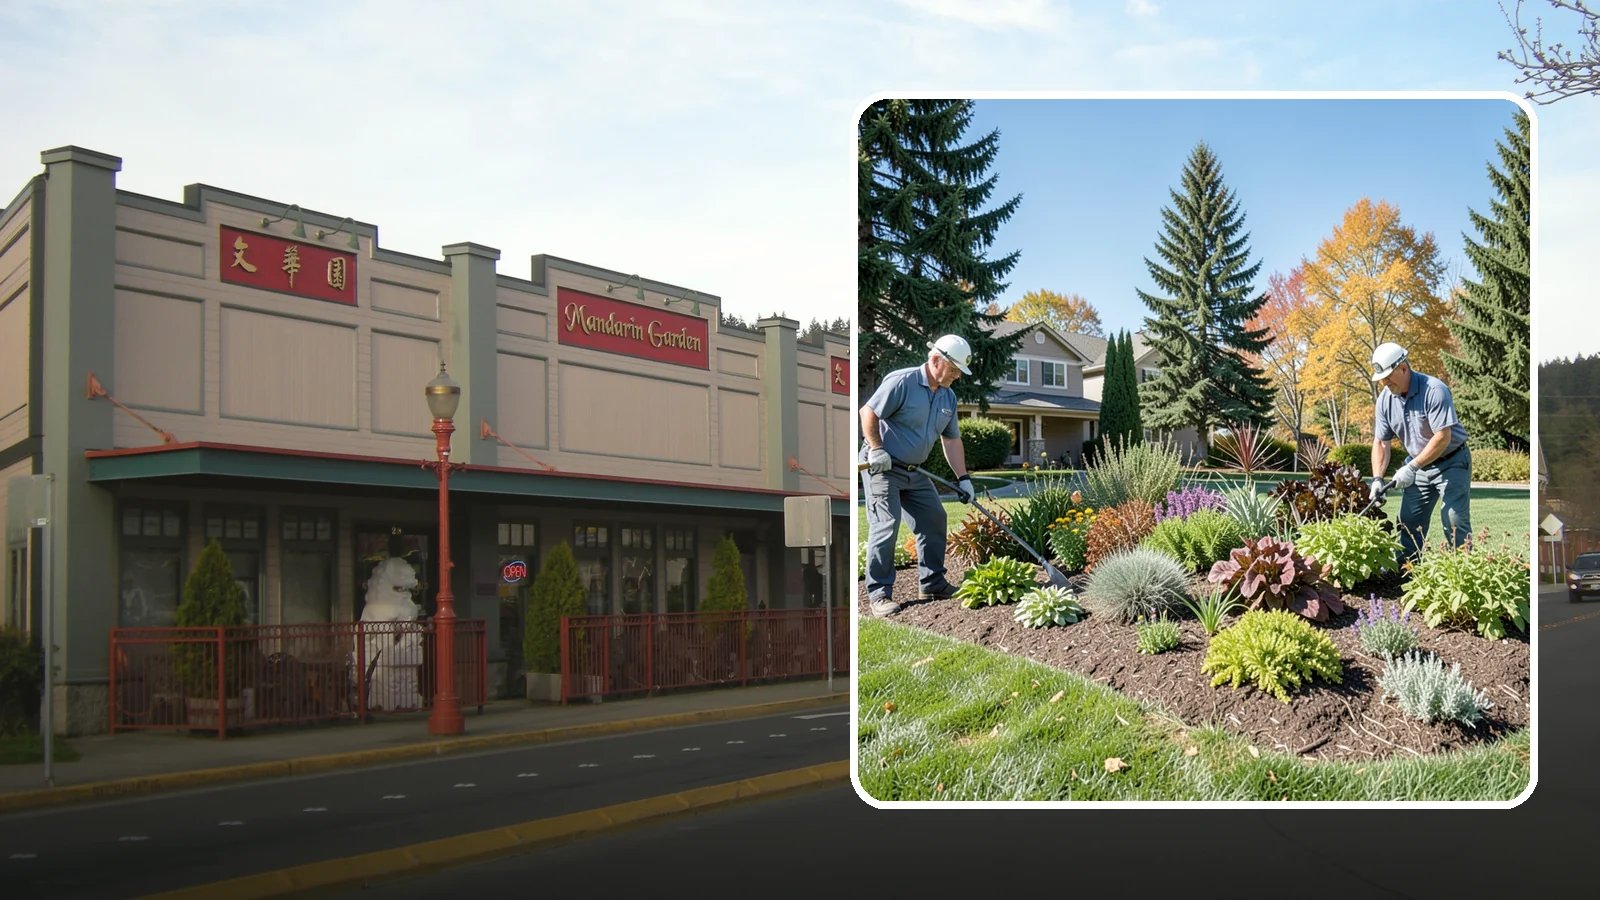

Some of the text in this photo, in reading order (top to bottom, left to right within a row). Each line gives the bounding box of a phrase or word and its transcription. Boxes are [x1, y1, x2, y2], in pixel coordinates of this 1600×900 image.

[231, 235, 346, 291] 文華園
[564, 302, 702, 352] Mandarin Garden
[503, 565, 527, 579] OPEN
